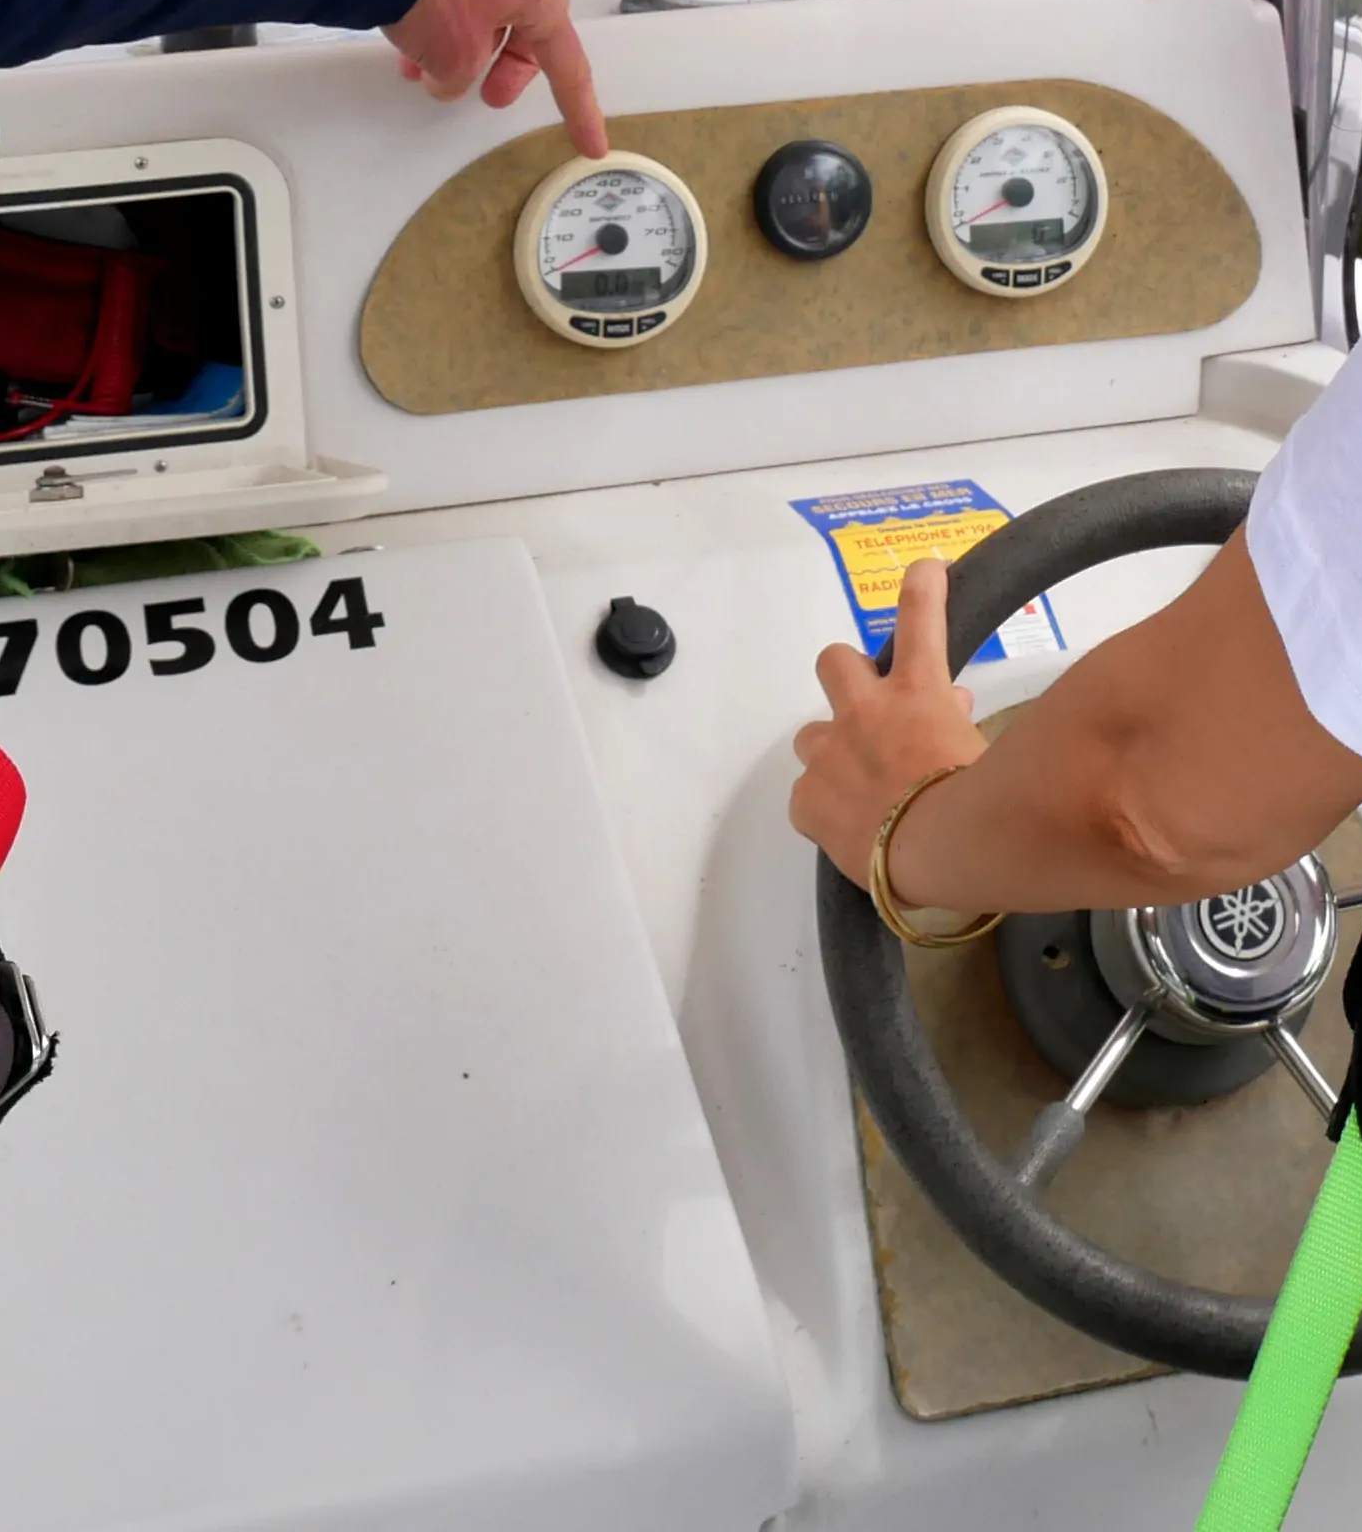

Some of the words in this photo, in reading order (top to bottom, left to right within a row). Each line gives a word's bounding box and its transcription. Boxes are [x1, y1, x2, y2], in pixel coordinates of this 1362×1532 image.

[597, 178, 622, 188] 40
[573, 189, 598, 199] 30
[620, 186, 645, 196] 50
[559, 208, 583, 218] 20
[644, 227, 668, 237] 70
[554, 233, 574, 242] 10
[858, 578, 903, 594] RADI
